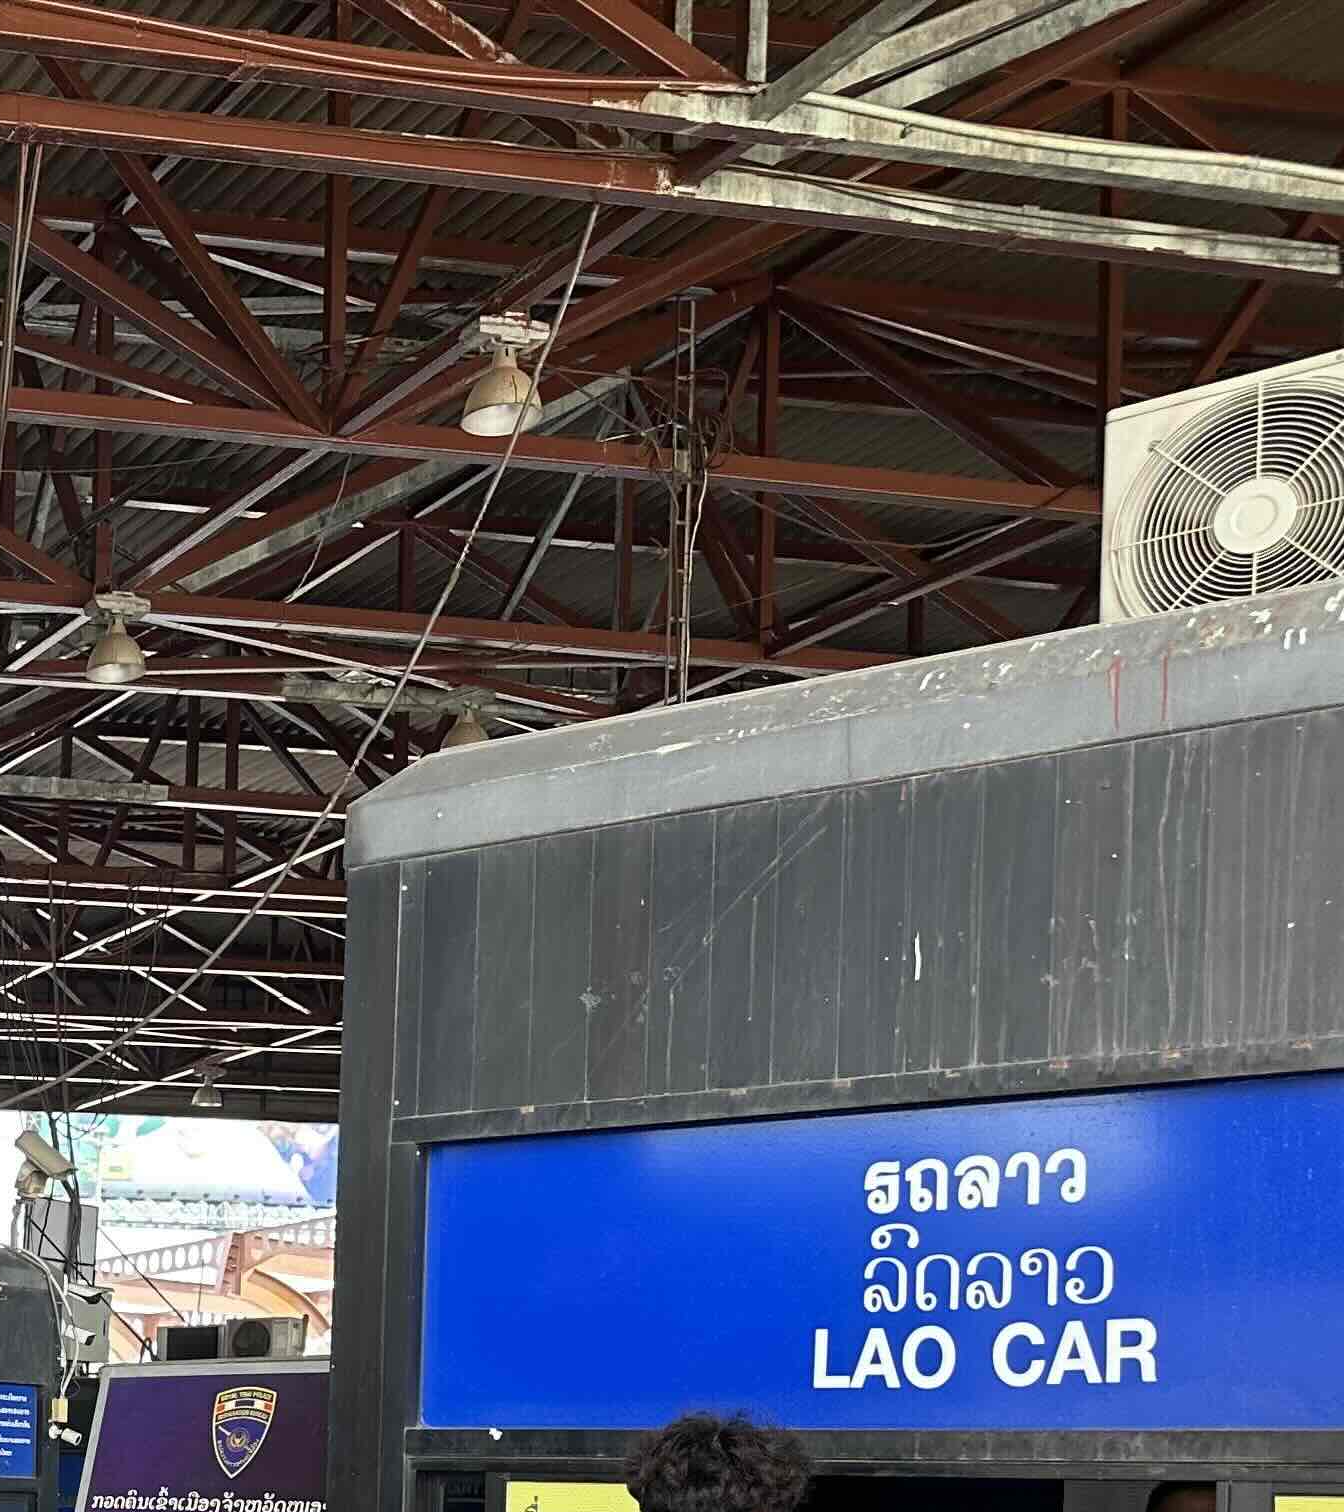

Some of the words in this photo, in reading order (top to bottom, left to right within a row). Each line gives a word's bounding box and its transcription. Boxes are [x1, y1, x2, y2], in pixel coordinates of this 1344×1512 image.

[863, 1147, 1088, 1215] รถลาว
[862, 1222, 1115, 1313] ລົດລາວ
[812, 1324, 957, 1390] LAO
[991, 1317, 1158, 1388] CAR
